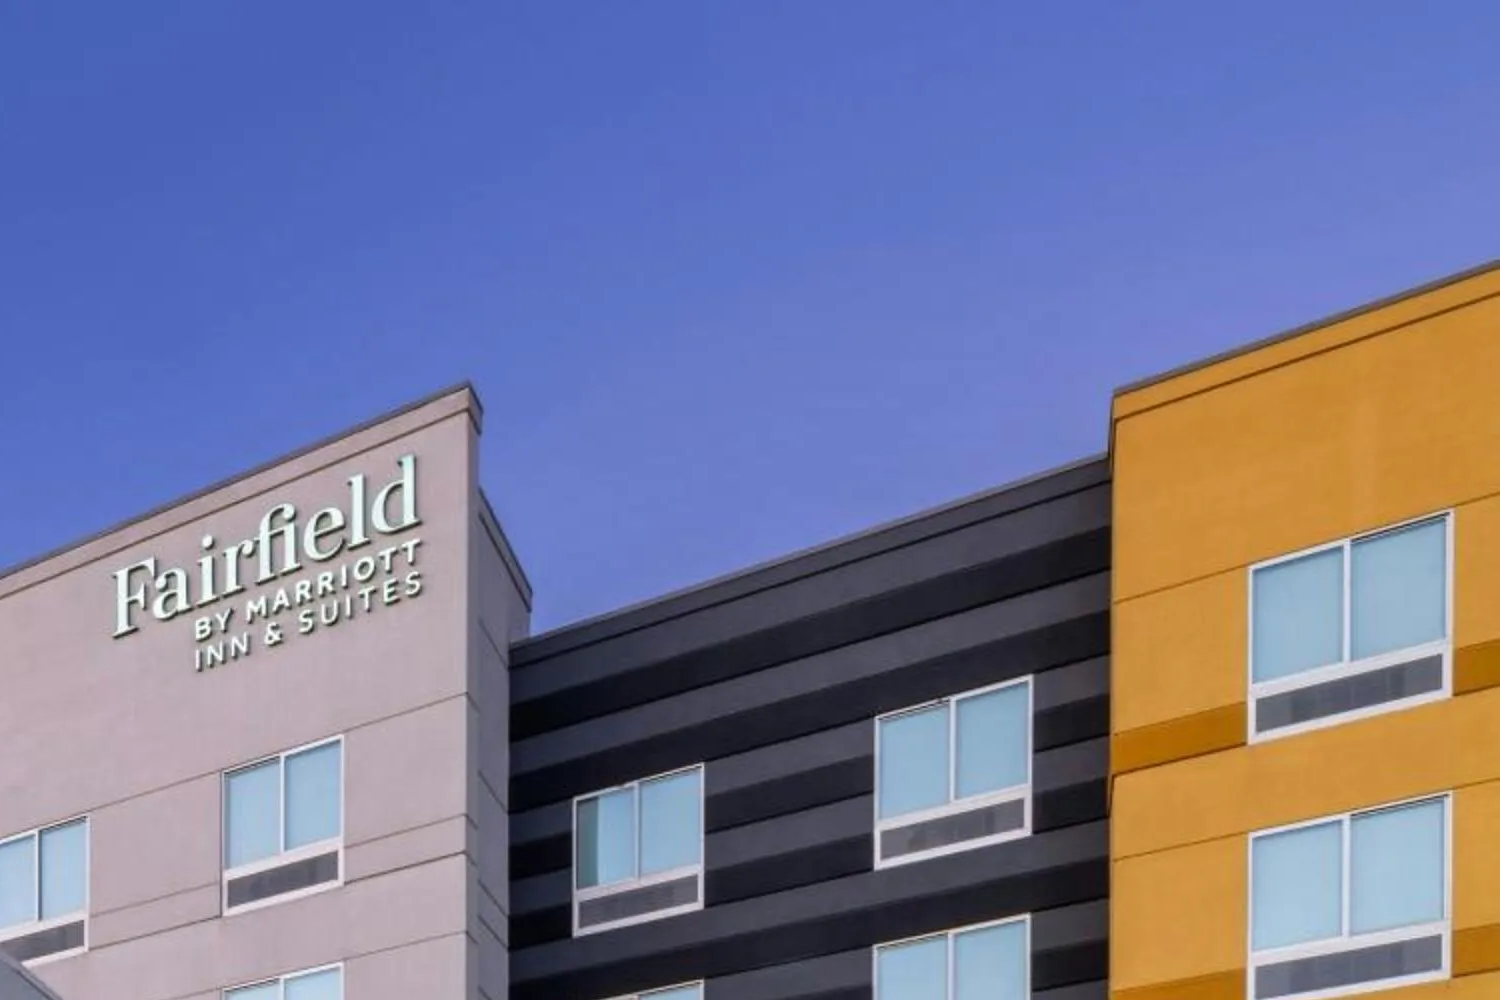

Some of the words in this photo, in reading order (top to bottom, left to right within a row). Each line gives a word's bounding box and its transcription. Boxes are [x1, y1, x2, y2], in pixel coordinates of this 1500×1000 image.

[112, 454, 422, 638] Fairfield
[195, 607, 234, 641] BY
[246, 538, 422, 623] MARRIOTT
[195, 632, 251, 672] INN
[264, 622, 284, 646] &
[299, 571, 422, 634] SUITES
